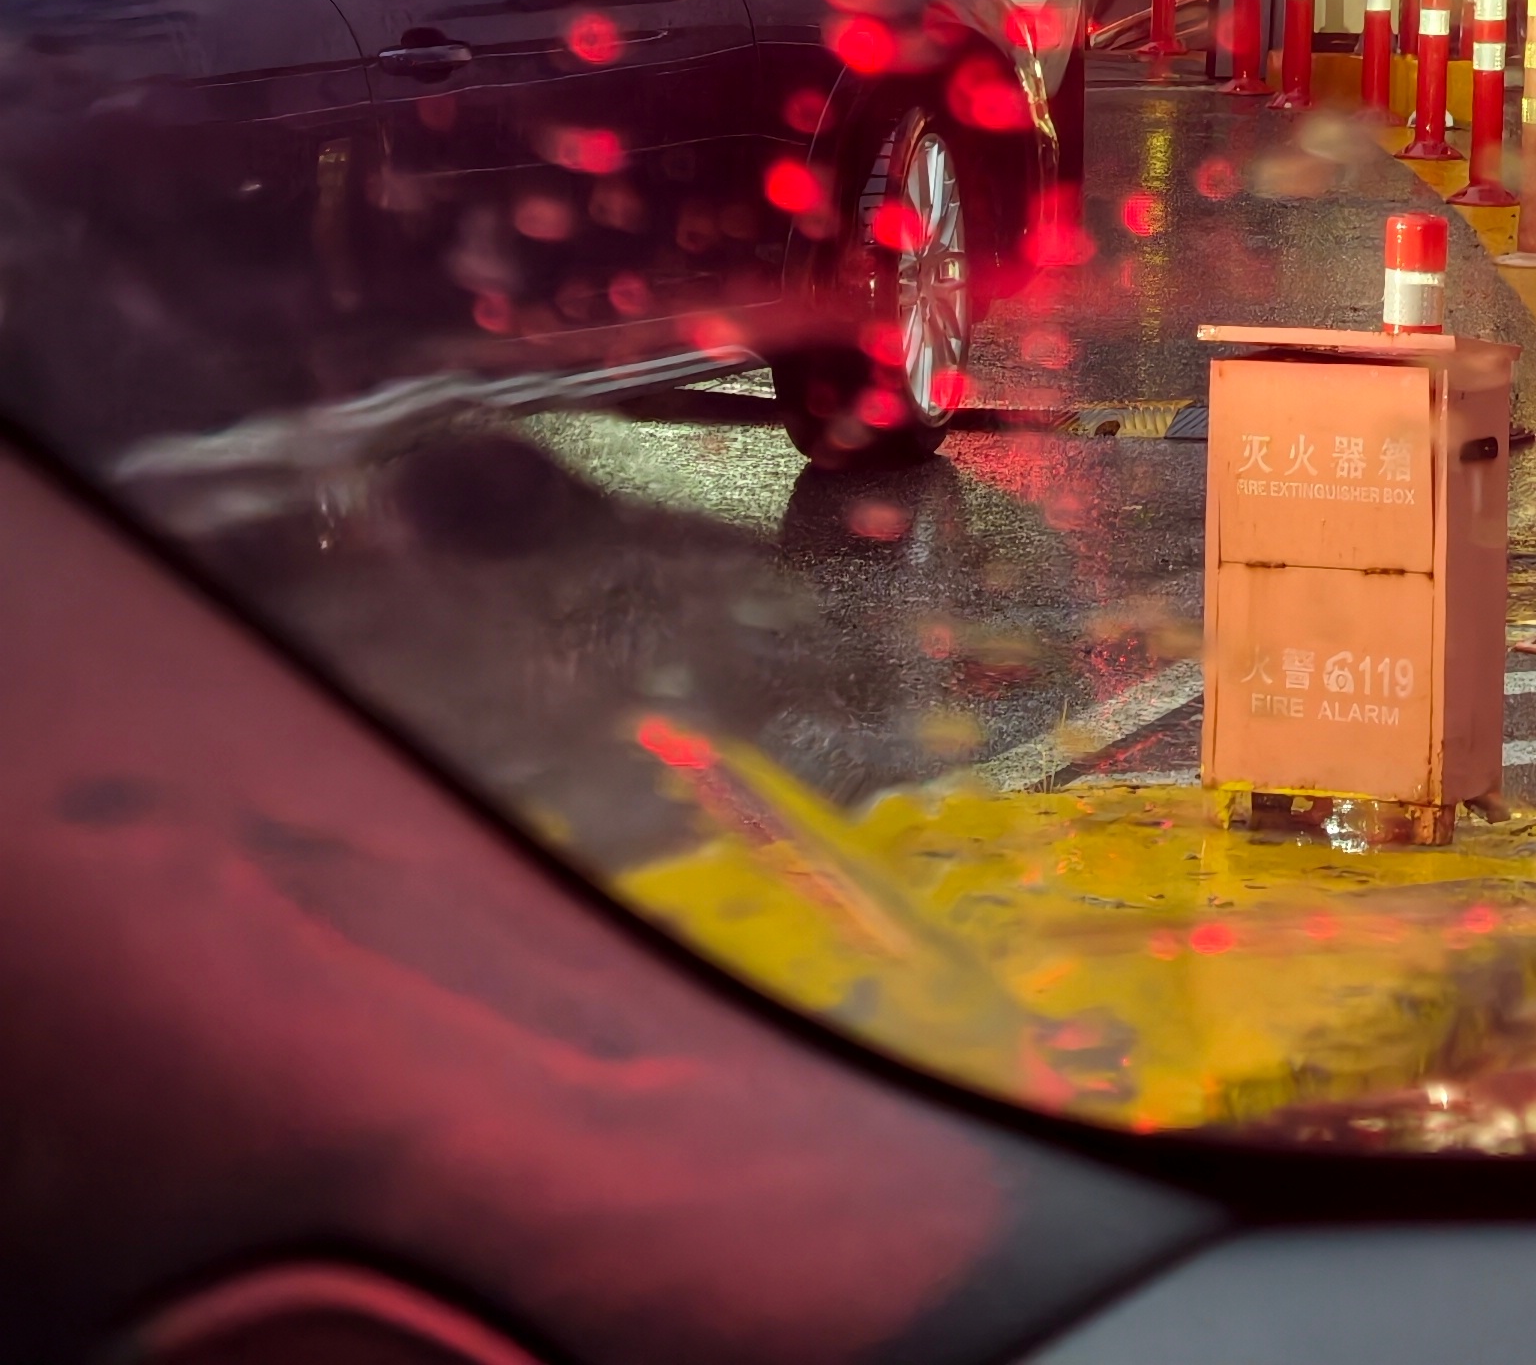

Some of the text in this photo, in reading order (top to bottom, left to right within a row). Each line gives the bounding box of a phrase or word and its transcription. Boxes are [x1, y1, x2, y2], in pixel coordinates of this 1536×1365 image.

[1238, 434, 1412, 482] 灭火器箱
[1237, 479, 1415, 505] FIRE EXTINGUISHER BOX
[1240, 643, 1415, 700] 火警 119
[1251, 692, 1399, 726] FIRE ALARM
